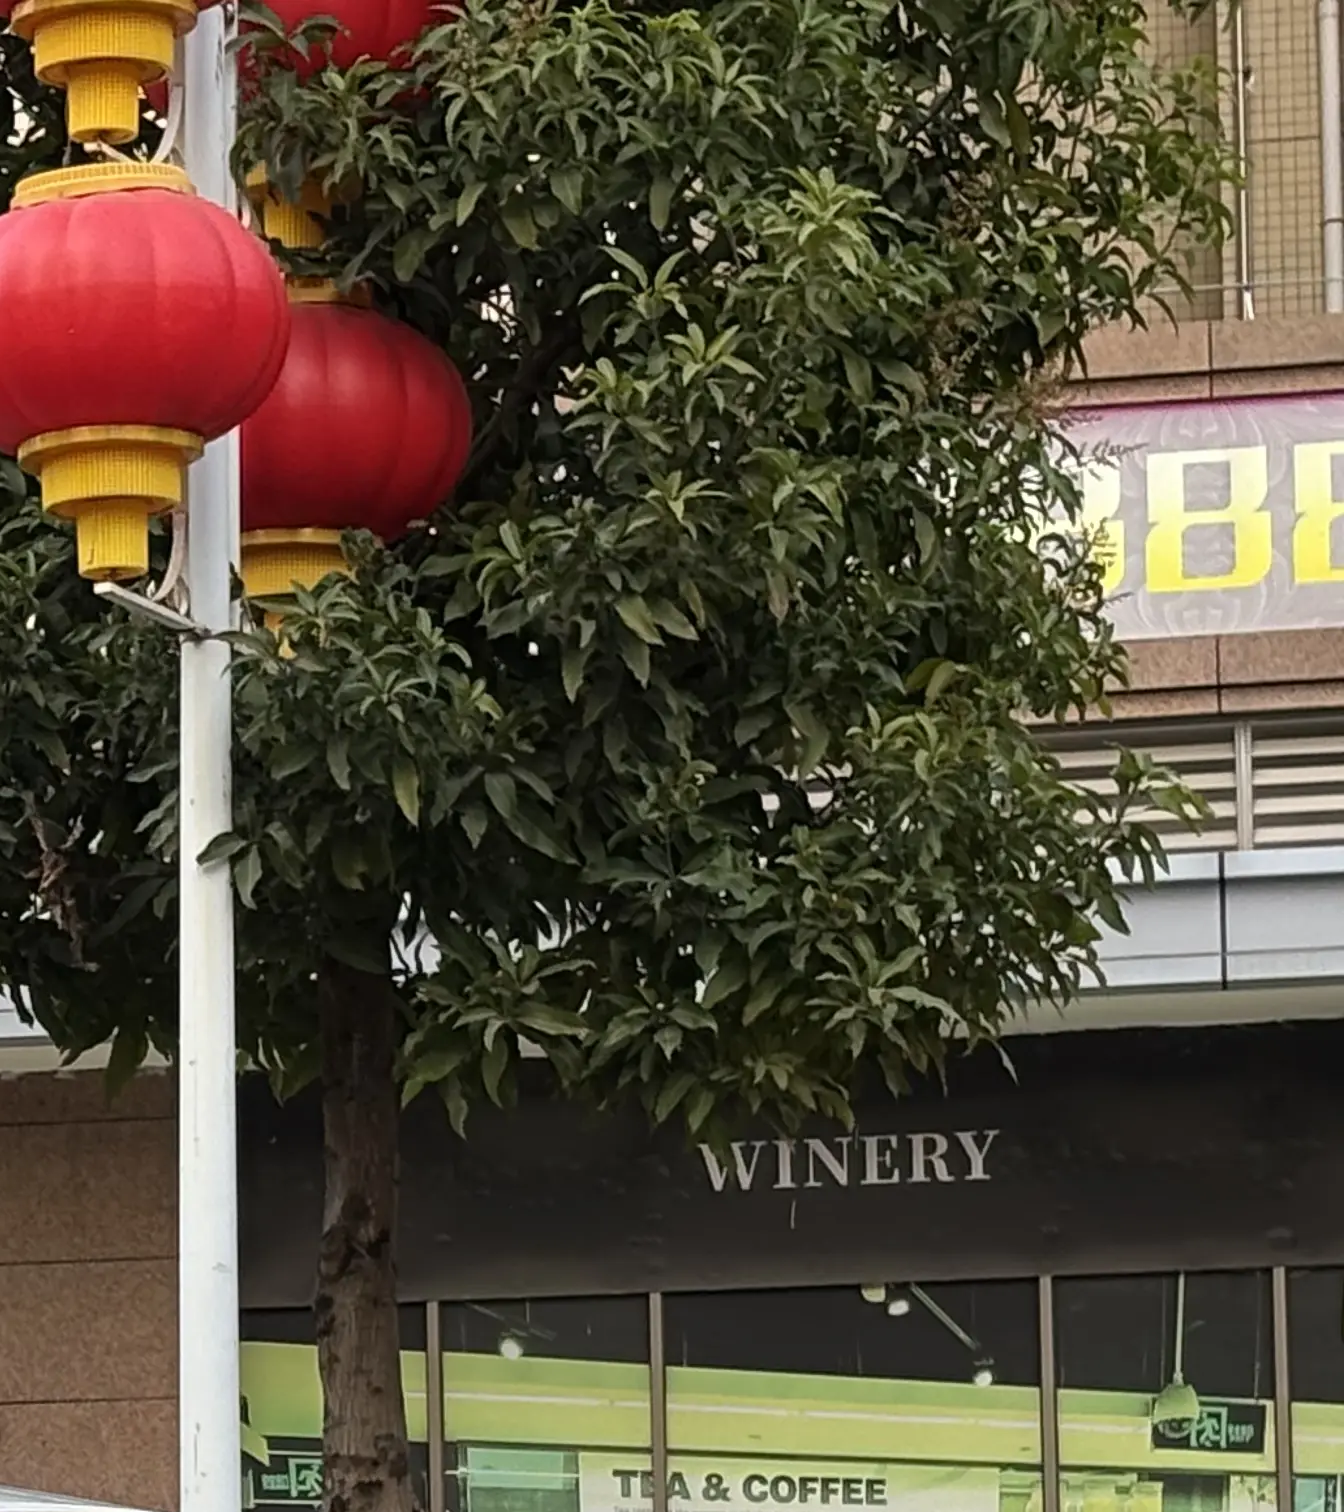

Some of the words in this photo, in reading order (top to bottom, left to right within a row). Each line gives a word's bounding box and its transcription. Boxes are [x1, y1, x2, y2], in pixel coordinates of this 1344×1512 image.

[697, 1129, 1000, 1191] WINERY
[612, 1469, 691, 1501] TEA
[701, 1473, 730, 1502] &
[742, 1474, 887, 1506] COFFEE
